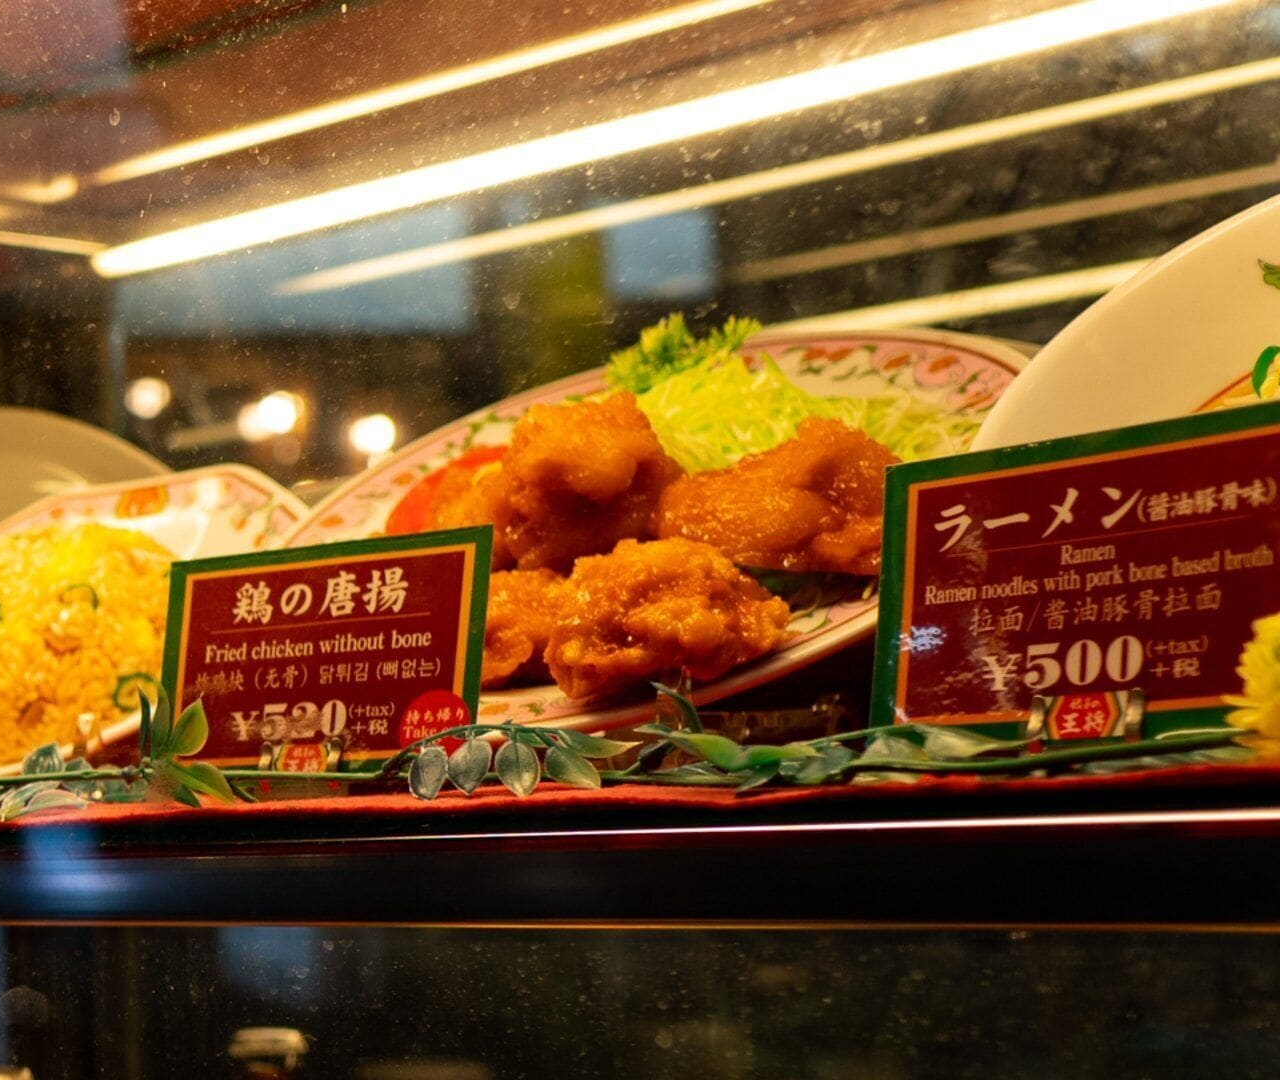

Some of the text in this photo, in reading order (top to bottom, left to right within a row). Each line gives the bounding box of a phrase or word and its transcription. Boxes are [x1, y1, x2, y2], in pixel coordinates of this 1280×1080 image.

[934, 486, 1143, 552] ラーメン
[924, 544, 1275, 606] Ramen noodles with pork bone based broth
[1059, 544, 1116, 566] Ramen
[231, 566, 409, 626] 鶏の唐揚
[204, 628, 432, 665] Fried chicken without bone
[981, 635, 1145, 692] ¥500
[230, 699, 396, 743] ¥520 (+tax)
[351, 719, 389, 737] +税
[403, 724, 438, 740] Take
[1060, 710, 1107, 736] 王将
